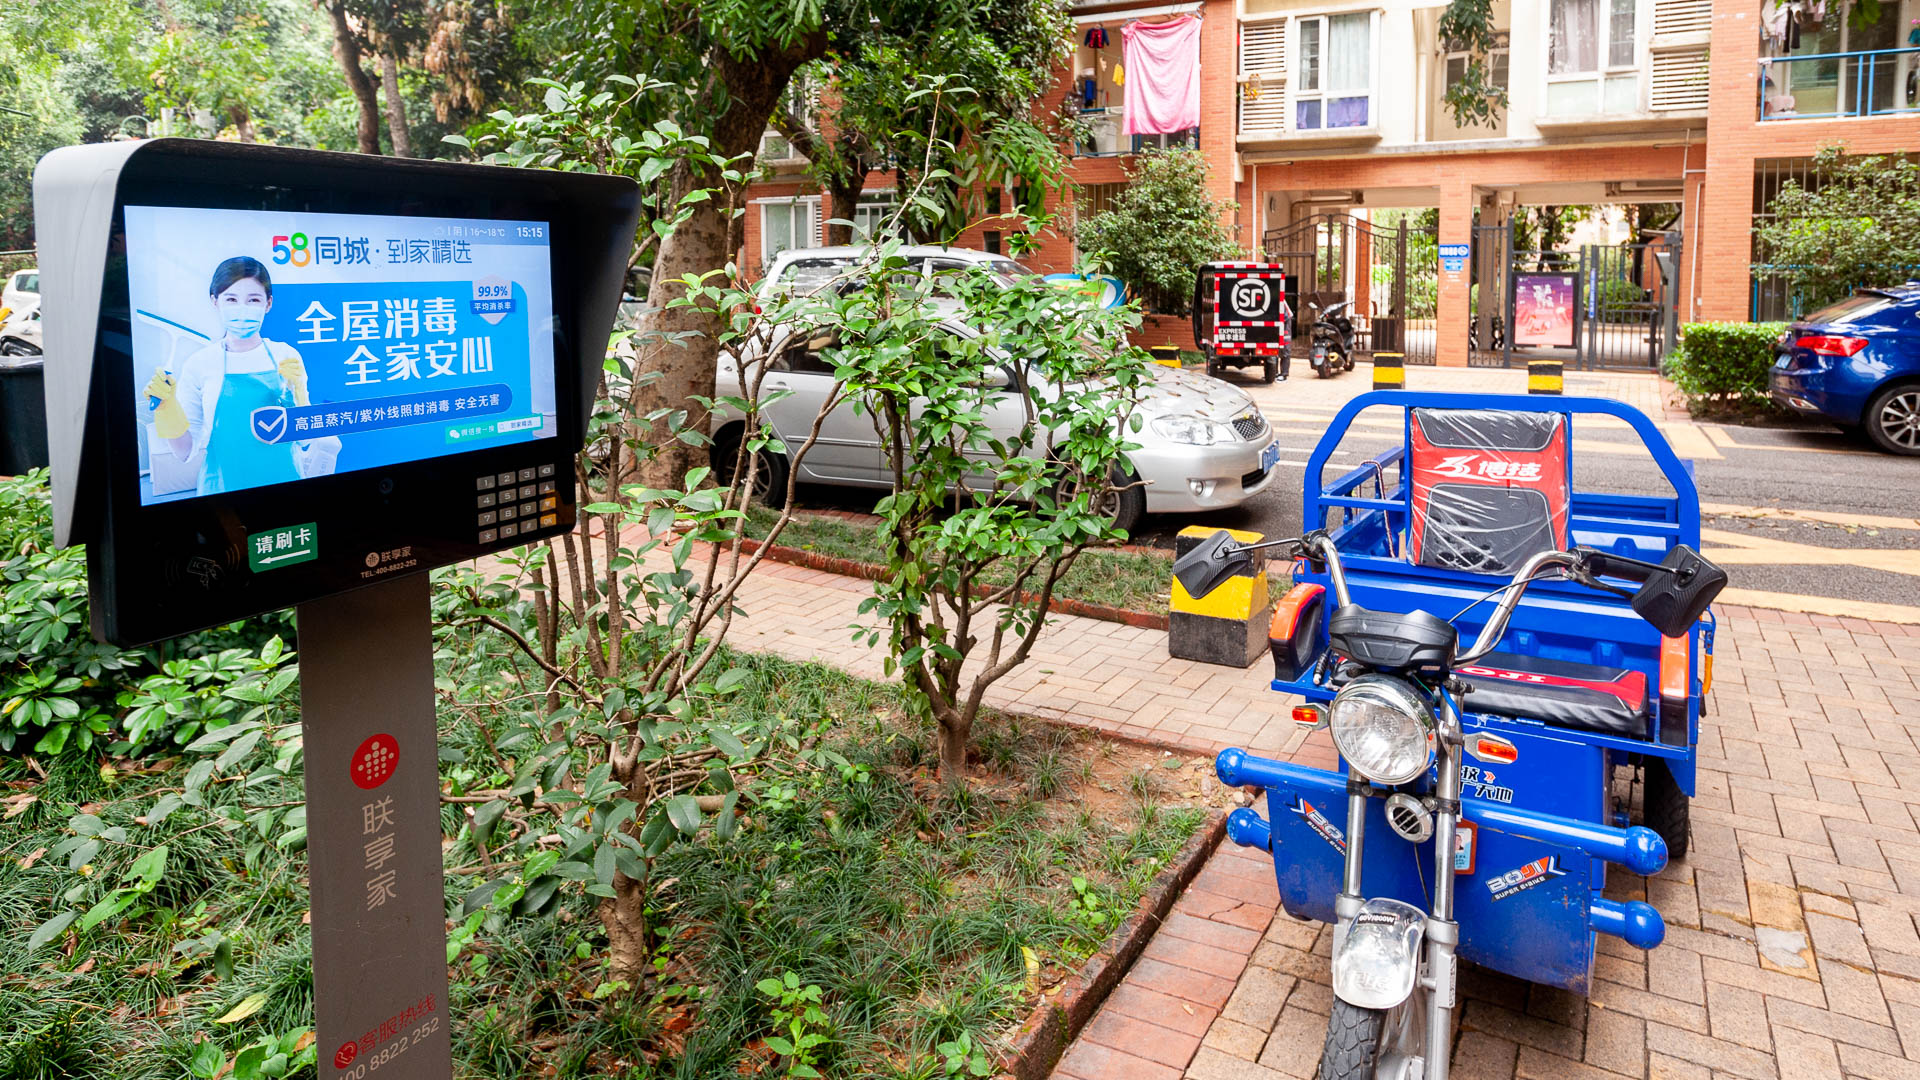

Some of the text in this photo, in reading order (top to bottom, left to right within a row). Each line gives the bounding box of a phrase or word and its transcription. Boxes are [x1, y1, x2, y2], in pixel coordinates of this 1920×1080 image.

[516, 227, 543, 238] 15:15
[478, 285, 508, 297] 99.9%
[1238, 288, 1264, 308] SF
[474, 301, 511, 311] 平均消杀率
[296, 297, 457, 344] 全屋消毒
[344, 336, 493, 386] 全家安心
[454, 393, 500, 411] 安全无害
[1477, 460, 1543, 482] 博技
[543, 517, 553, 526] OK
[255, 528, 312, 554] 请刷卡
[1462, 667, 1547, 683] OJI
[1306, 809, 1347, 849] BO
[362, 795, 397, 911] 联享家
[1485, 860, 1545, 894] BOJI
[1494, 886, 1520, 900] SUPER
[359, 992, 436, 1055] 客服热线
[370, 1037, 408, 1071] 8822
[412, 1016, 440, 1045] 252
